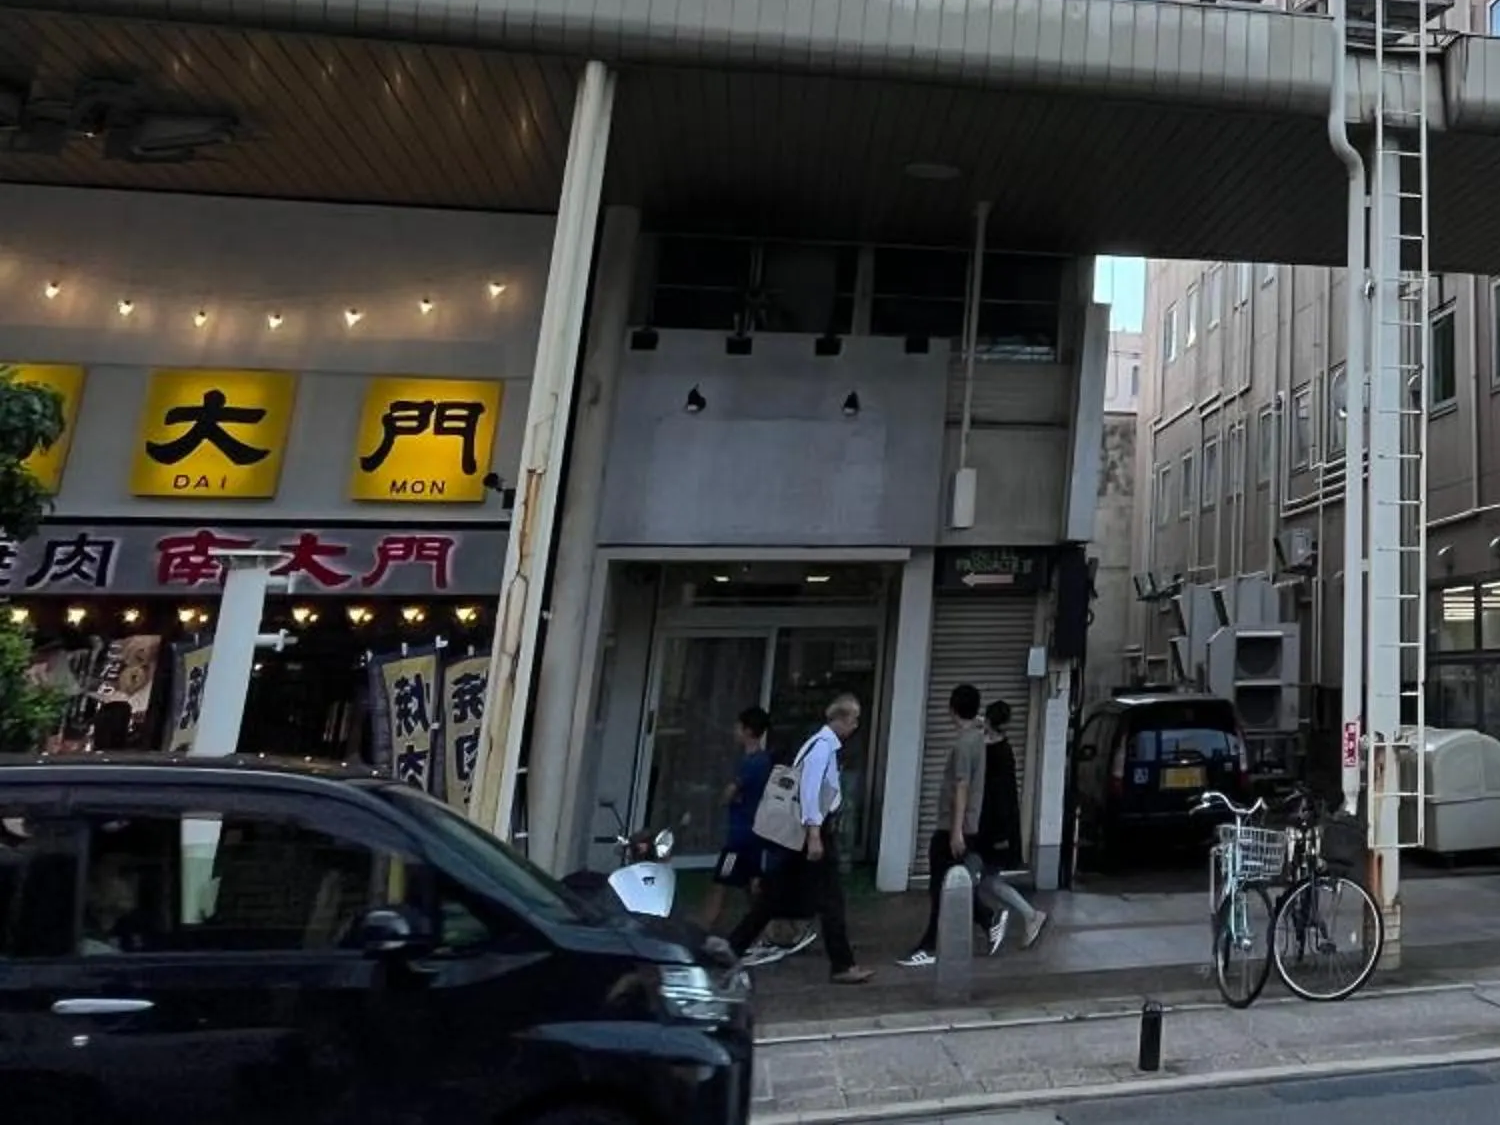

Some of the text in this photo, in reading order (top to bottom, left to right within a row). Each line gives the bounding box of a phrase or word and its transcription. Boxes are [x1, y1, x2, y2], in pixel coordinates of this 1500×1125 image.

[146, 389, 486, 475] 大 門
[173, 474, 445, 494] DAI MON
[0, 529, 454, 589] 肉 南大門
